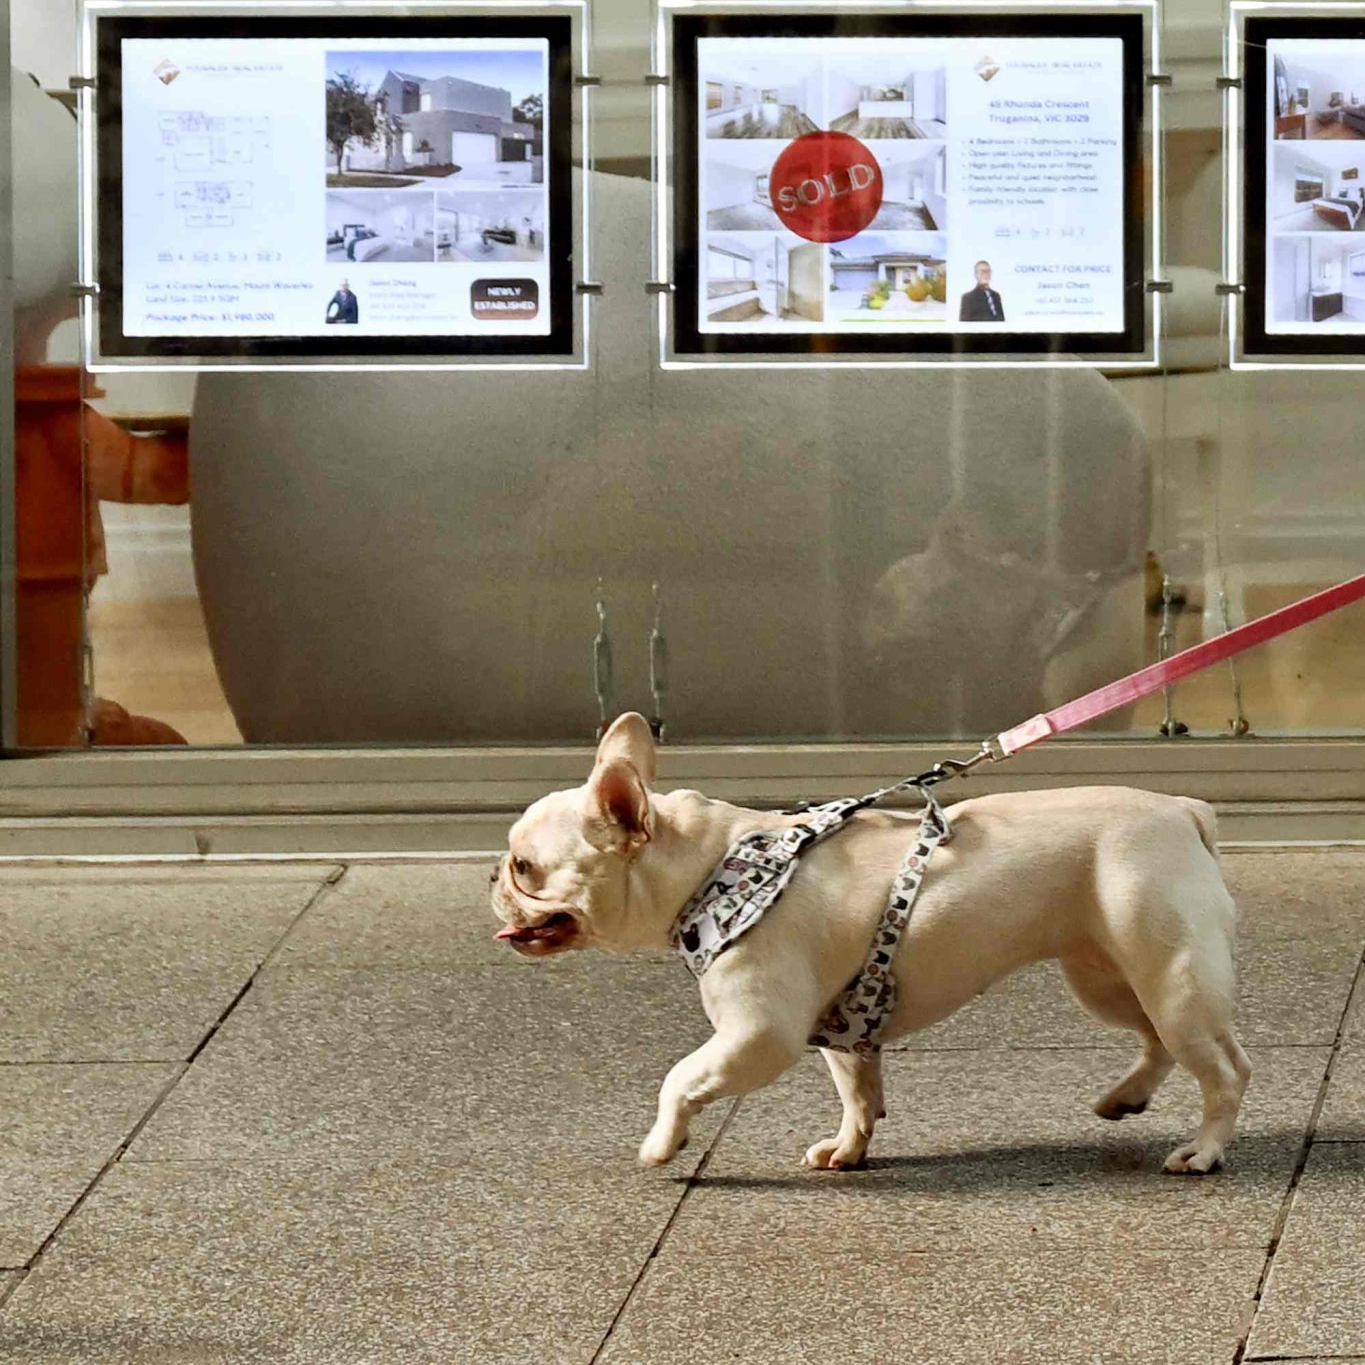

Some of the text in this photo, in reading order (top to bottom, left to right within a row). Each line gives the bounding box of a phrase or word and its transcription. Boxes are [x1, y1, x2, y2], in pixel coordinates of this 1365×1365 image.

[1004, 101, 1042, 109] Rhonda
[1045, 101, 1090, 109] Crescent
[990, 114, 1090, 124] Truganina, VIC 3029
[778, 164, 874, 212] SOLD
[1015, 265, 1111, 274] CONTACT FOR PRICE
[488, 288, 521, 297] NEWLY
[472, 301, 536, 312] ESTABLISHED
